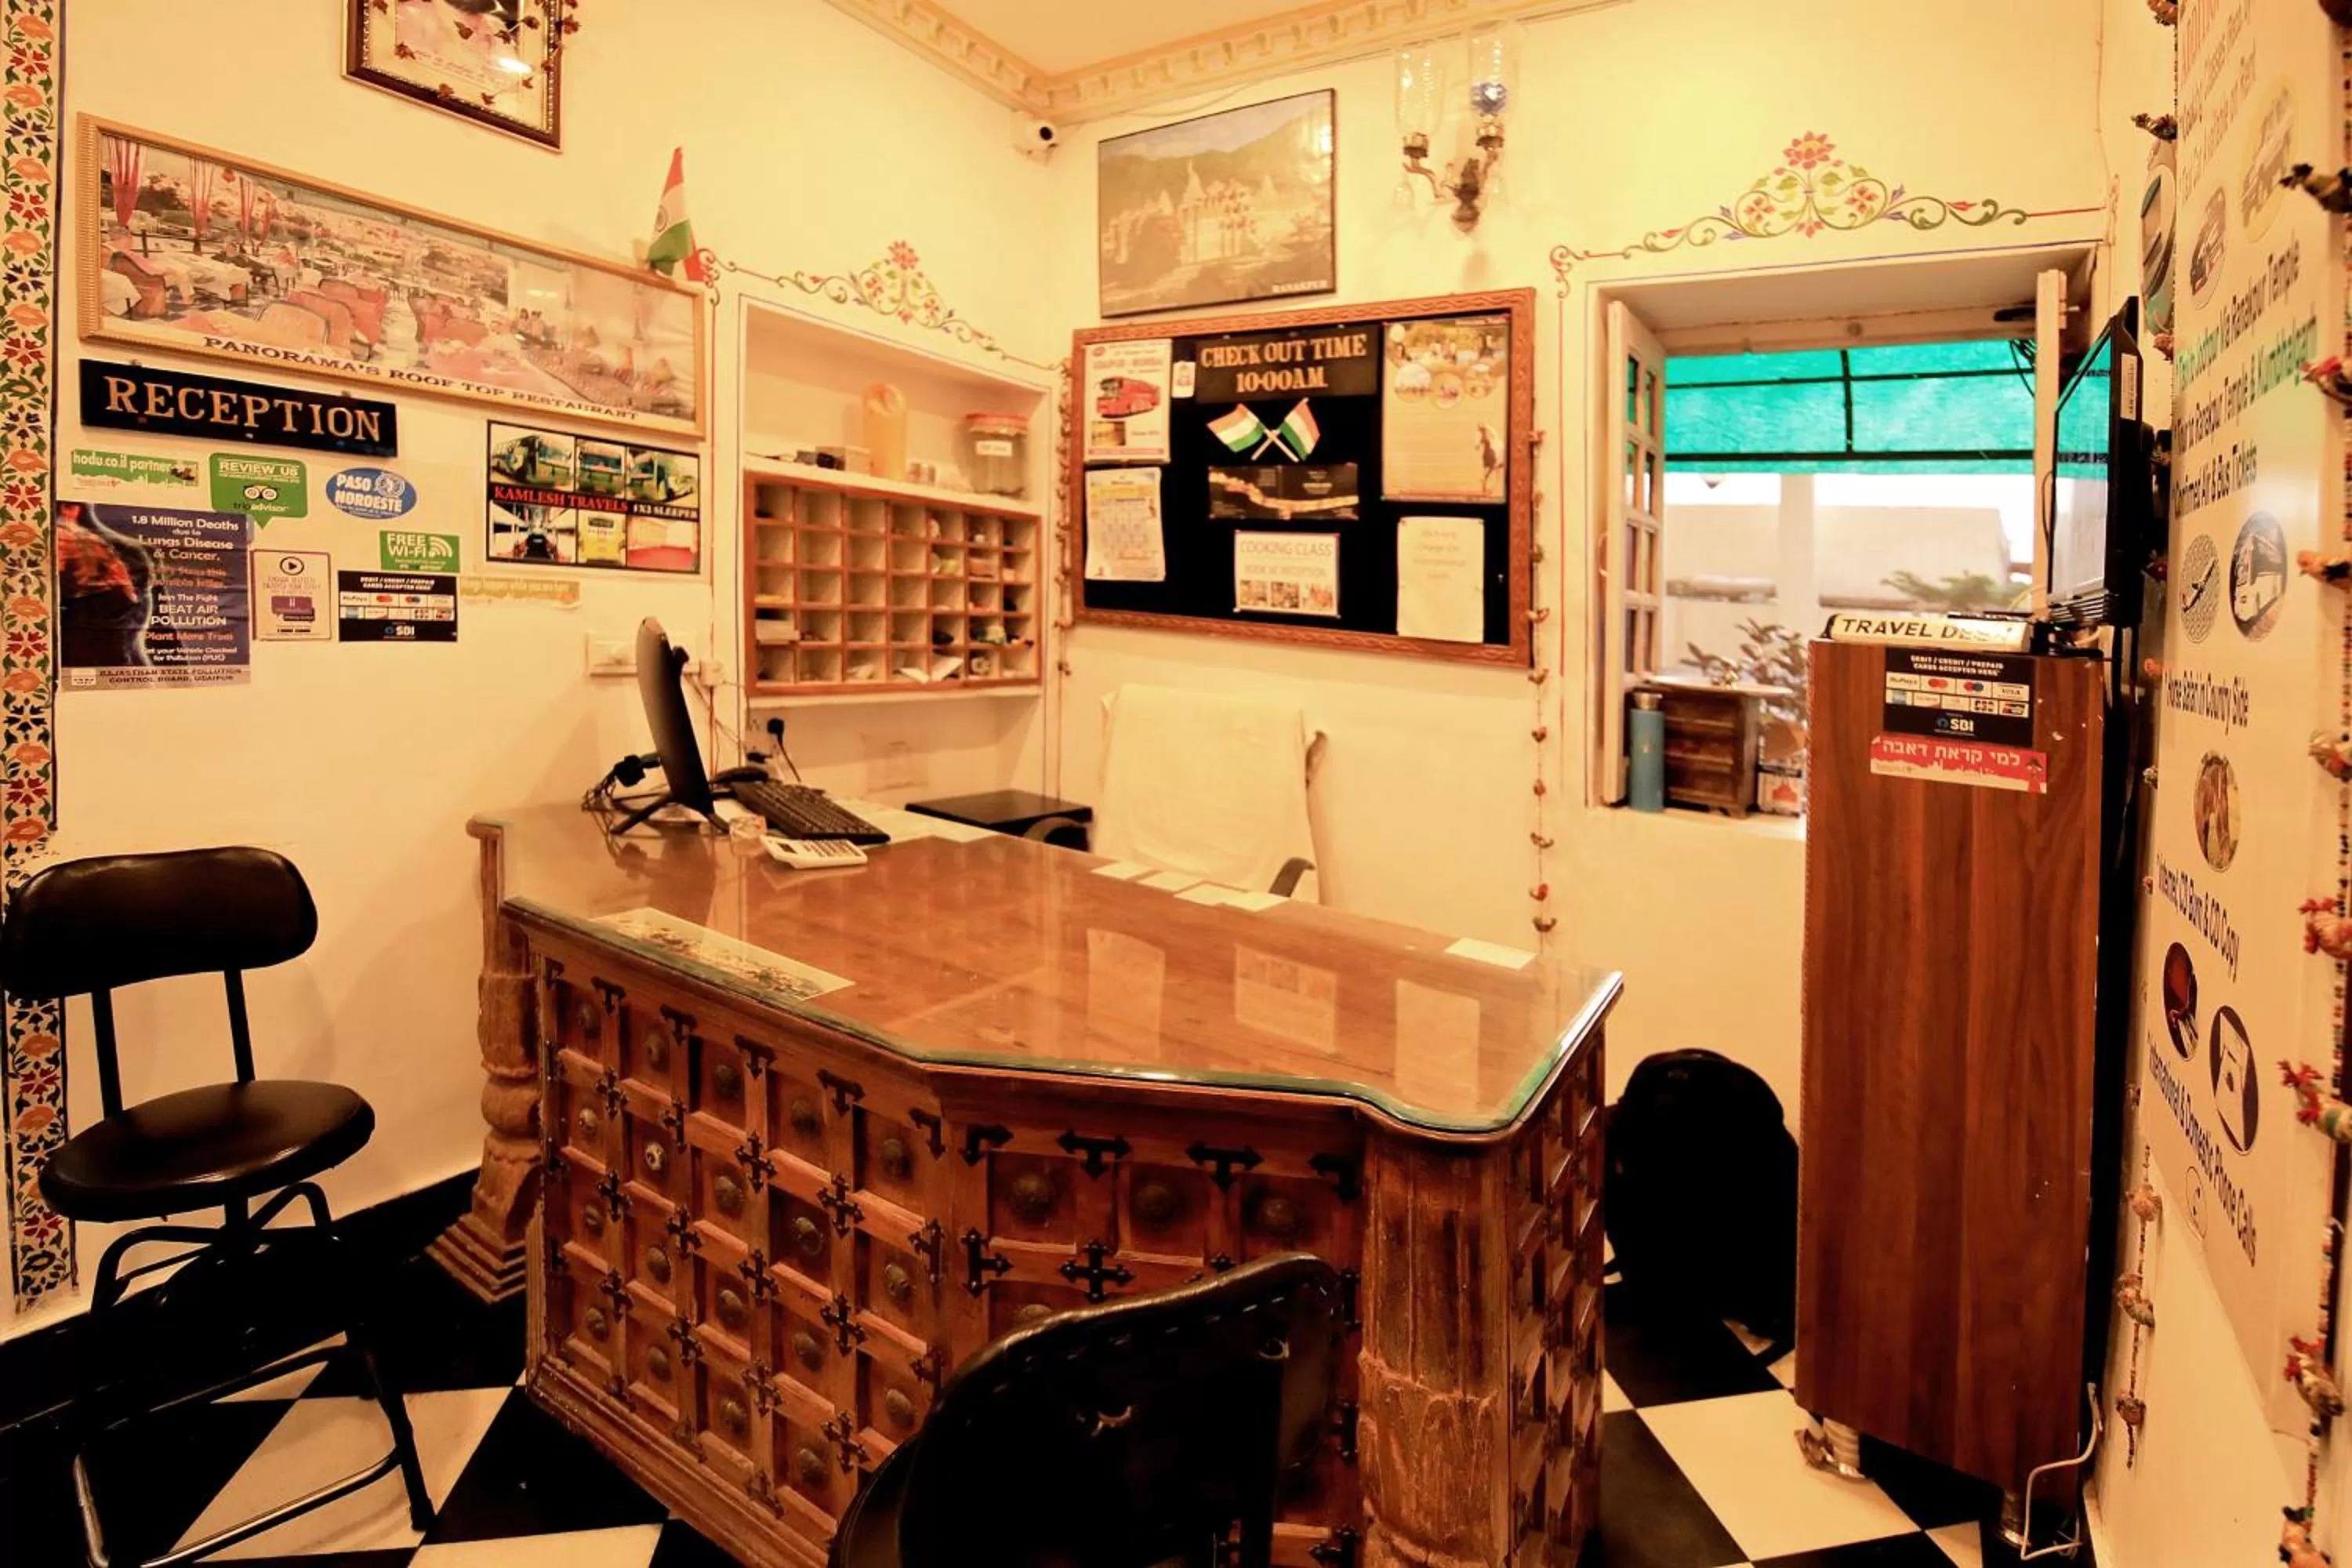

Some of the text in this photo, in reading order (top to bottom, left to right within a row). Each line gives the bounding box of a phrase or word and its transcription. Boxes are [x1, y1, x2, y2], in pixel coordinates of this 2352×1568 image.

[2231, 274, 2267, 344] Ranakpur
[2268, 228, 2299, 305] Temple
[1200, 334, 1367, 368] CHECK OUT TIME
[203, 336, 639, 420] PANORAMA'S ROOF TOP RESTAURANT
[103, 376, 380, 443] RECEPTION
[2195, 391, 2223, 445] Ranakpur
[2224, 362, 2248, 426] Temple
[73, 451, 127, 468] hodu.co.il
[220, 462, 298, 476] REVIEW US
[2218, 454, 2230, 499] Bus
[2232, 441, 2257, 489] Tickets
[336, 473, 372, 492] PASO
[233, 501, 289, 512] tripadvisor
[494, 485, 565, 506] KAMLESH
[568, 494, 628, 512] TRAVELS
[132, 515, 239, 532] 1.8 Million Deaths
[140, 535, 234, 550] Lungs Disease
[387, 532, 426, 546] FREE
[153, 549, 220, 561] & Cancer.
[387, 546, 426, 557] WI-FI
[1296, 542, 1333, 556] CLASS
[178, 593, 194, 602] The
[159, 604, 220, 614] BEAT AIR
[151, 615, 227, 626] POLLUTION
[1842, 618, 1933, 638] TRAVEL
[145, 632, 174, 641] Plant
[2205, 673, 2231, 735] Country
[2232, 677, 2249, 727] Side
[1950, 717, 1974, 731] SBI
[1882, 740, 2020, 766] למי קראת דאבה
[2221, 909, 2240, 983] Copy
[2214, 1144, 2236, 1226] Phone
[2238, 1189, 2256, 1268] Calls
